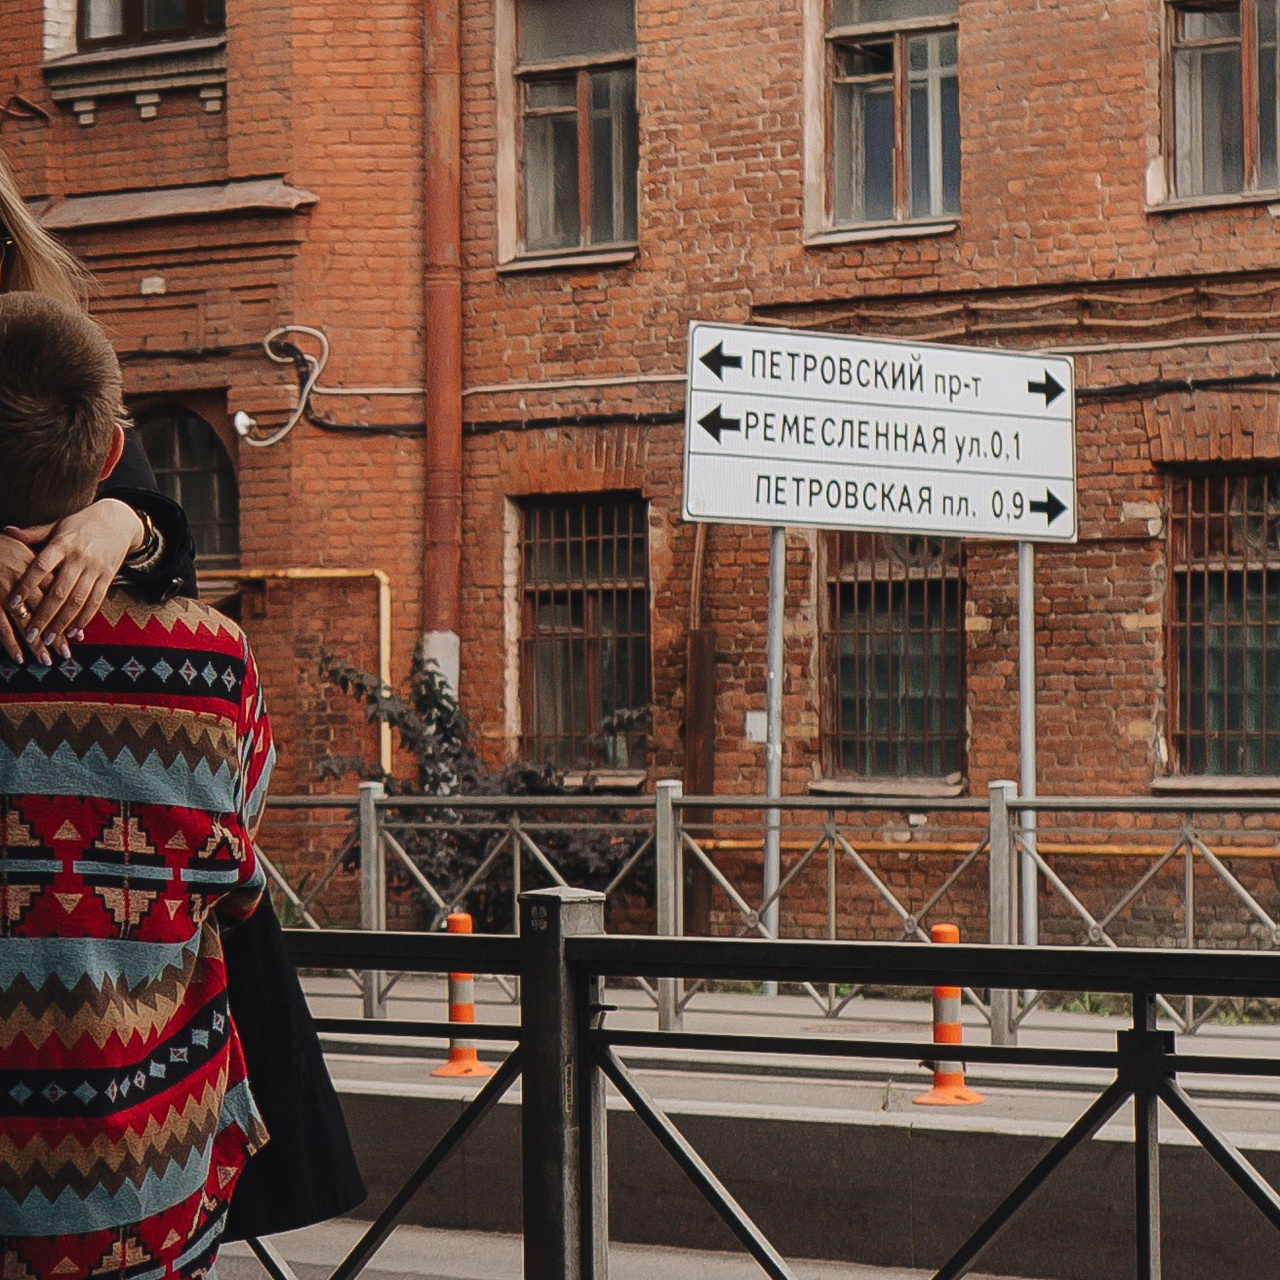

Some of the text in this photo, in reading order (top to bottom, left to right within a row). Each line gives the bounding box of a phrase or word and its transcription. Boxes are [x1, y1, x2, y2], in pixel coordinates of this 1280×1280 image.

[751, 349, 982, 402] ПЕТРОВСКИЙ пр-т
[745, 411, 946, 455] РЕМЕСЛЕННАЯ
[755, 474, 1024, 521] ПЕТРОВСКАЯ пл. 0,9
